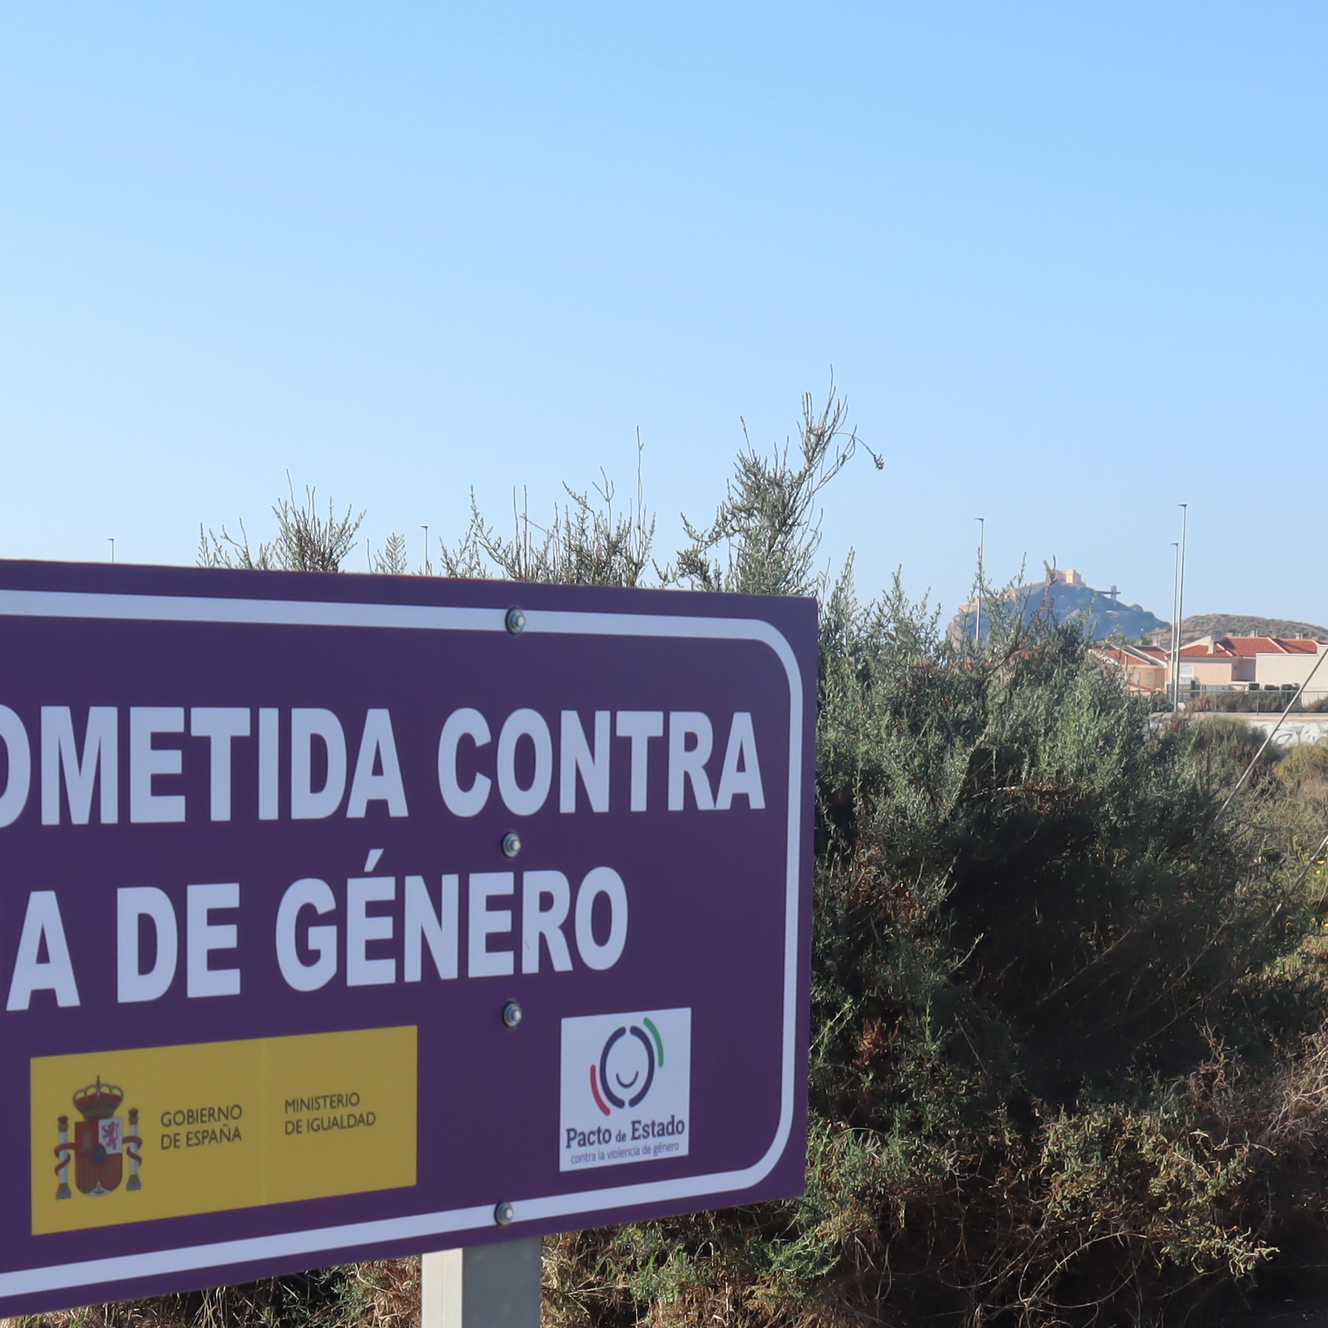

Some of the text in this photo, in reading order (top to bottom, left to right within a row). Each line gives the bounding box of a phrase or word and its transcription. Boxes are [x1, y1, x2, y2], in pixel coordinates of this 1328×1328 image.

[437, 707, 766, 818] CONTRA
[116, 882, 241, 1004] DE
[275, 849, 629, 992] GÉNERO
[160, 1104, 243, 1128] GOBIERNO
[284, 1092, 361, 1114] MINISTERIO
[160, 1123, 243, 1150] DE ESPAÑA
[284, 1111, 377, 1136] DE IGUALDAD
[565, 1114, 685, 1149] Pacto de Estado
[571, 1141, 680, 1165] contra la violencia de género
